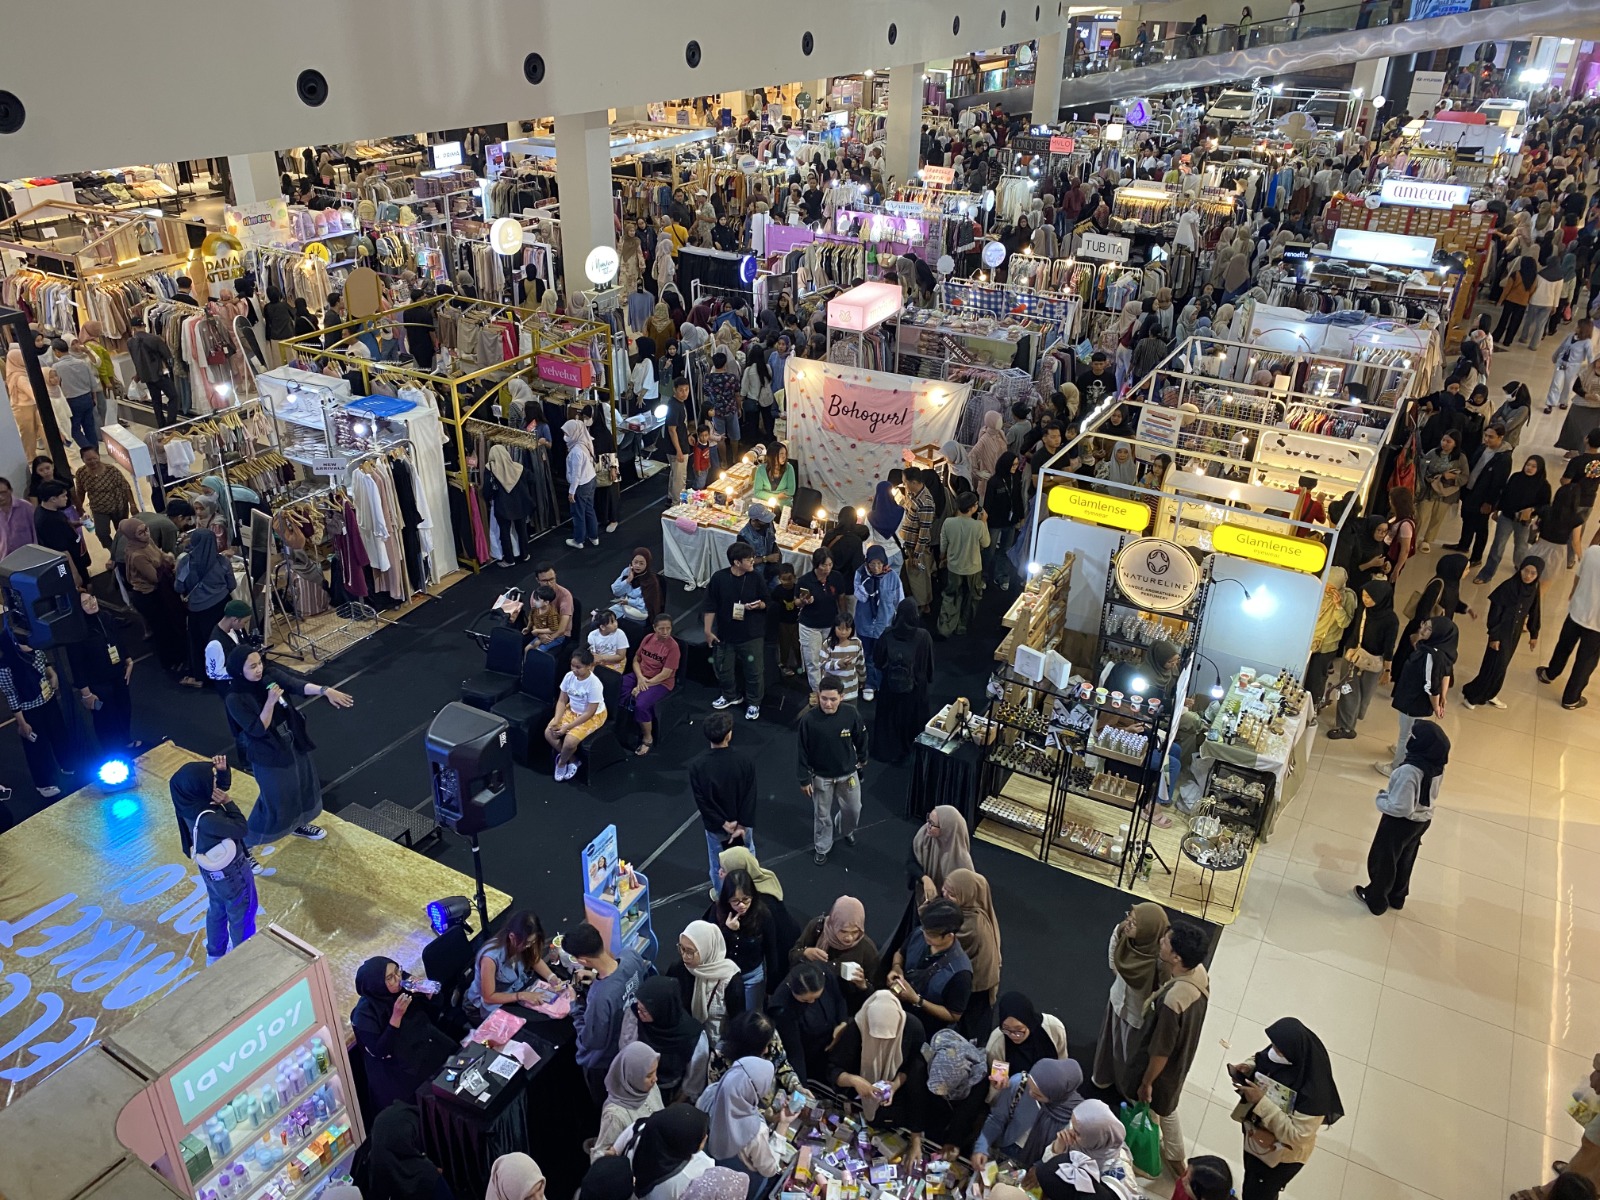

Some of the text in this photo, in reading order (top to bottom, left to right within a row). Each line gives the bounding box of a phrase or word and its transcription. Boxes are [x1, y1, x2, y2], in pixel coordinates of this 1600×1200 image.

[1012, 139, 1049, 150] HONEY BEE
[1393, 185, 1457, 202] ameene
[943, 336, 971, 363] BEST SELLER
[542, 366, 578, 382] velvelux
[1069, 494, 1127, 516] Glamlense
[1236, 533, 1302, 557] Glamlense
[1123, 571, 1188, 591] NATURELINE
[1140, 591, 1168, 601] PERFUMERY
[0, 892, 201, 1011] ARKET
[183, 1000, 302, 1102] lavojoy
